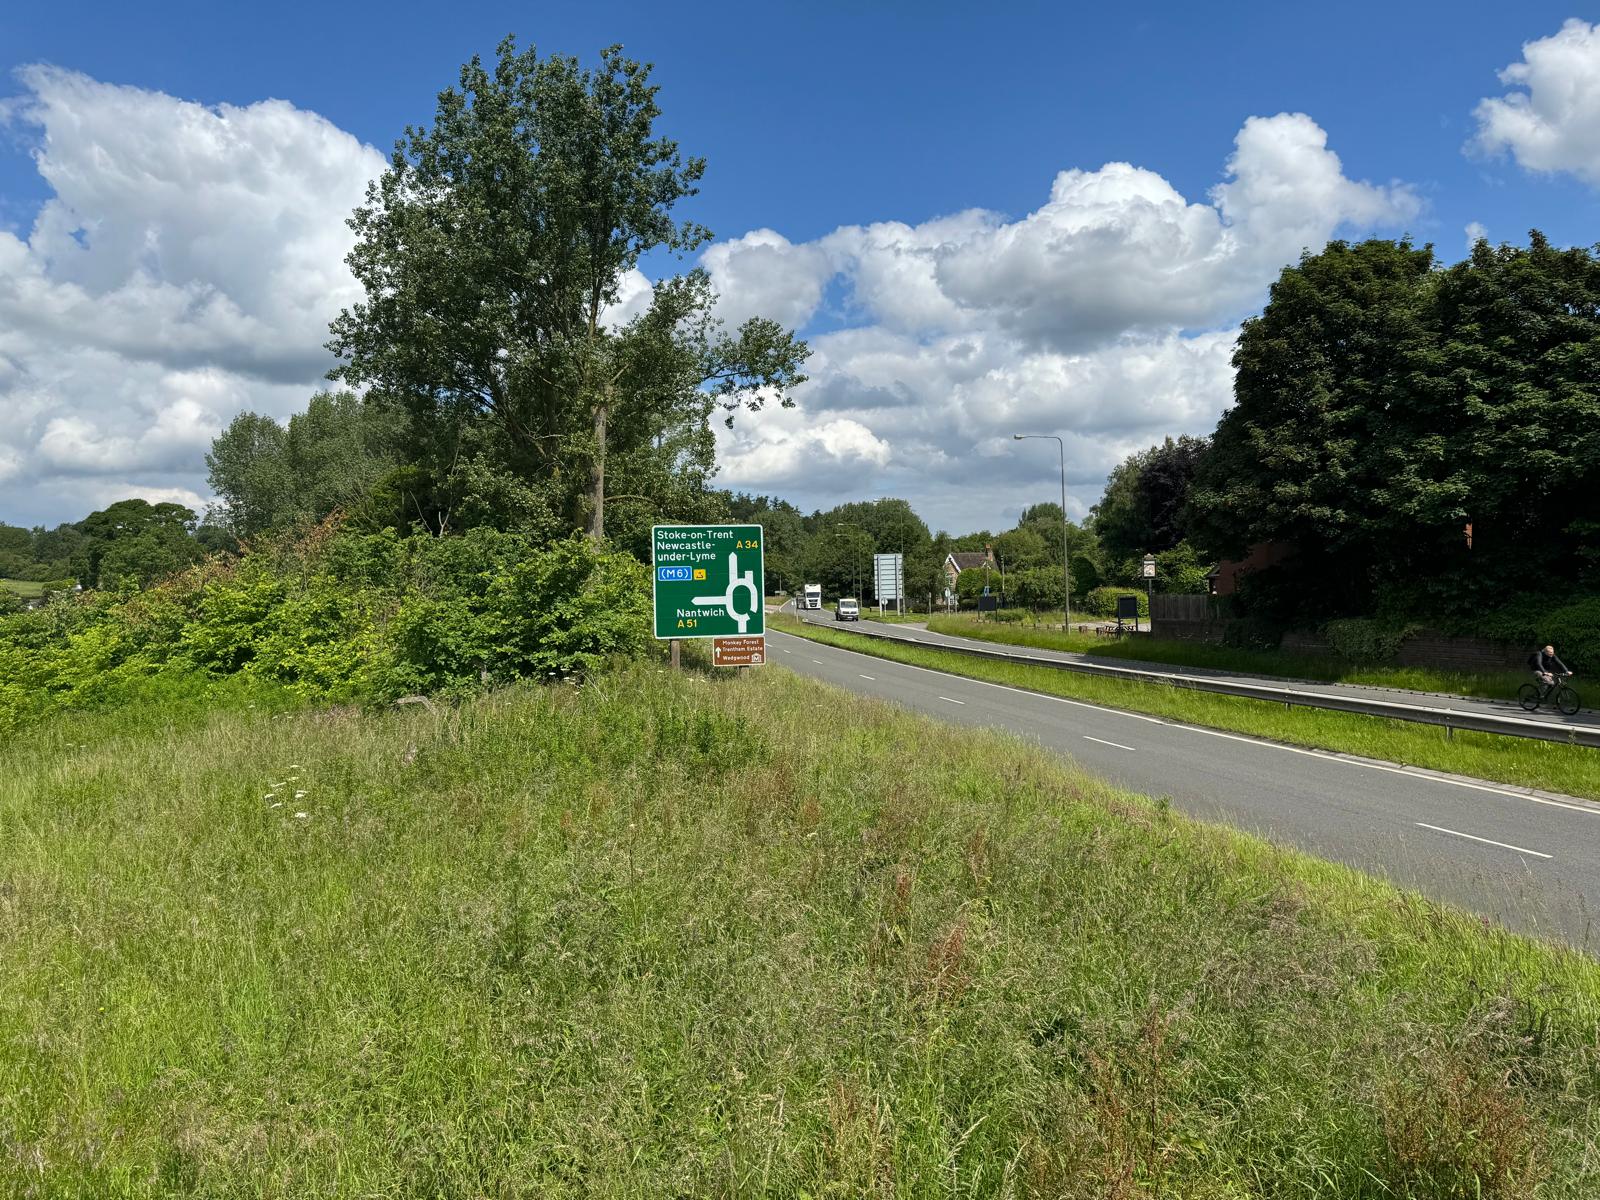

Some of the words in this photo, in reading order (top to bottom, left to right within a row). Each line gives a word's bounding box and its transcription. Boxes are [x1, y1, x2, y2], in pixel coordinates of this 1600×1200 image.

[657, 530, 734, 539] Stoke-on-Trent
[657, 541, 715, 550] Newcastle-
[657, 552, 716, 562] under-Lyme
[676, 608, 725, 617] Nantwich
